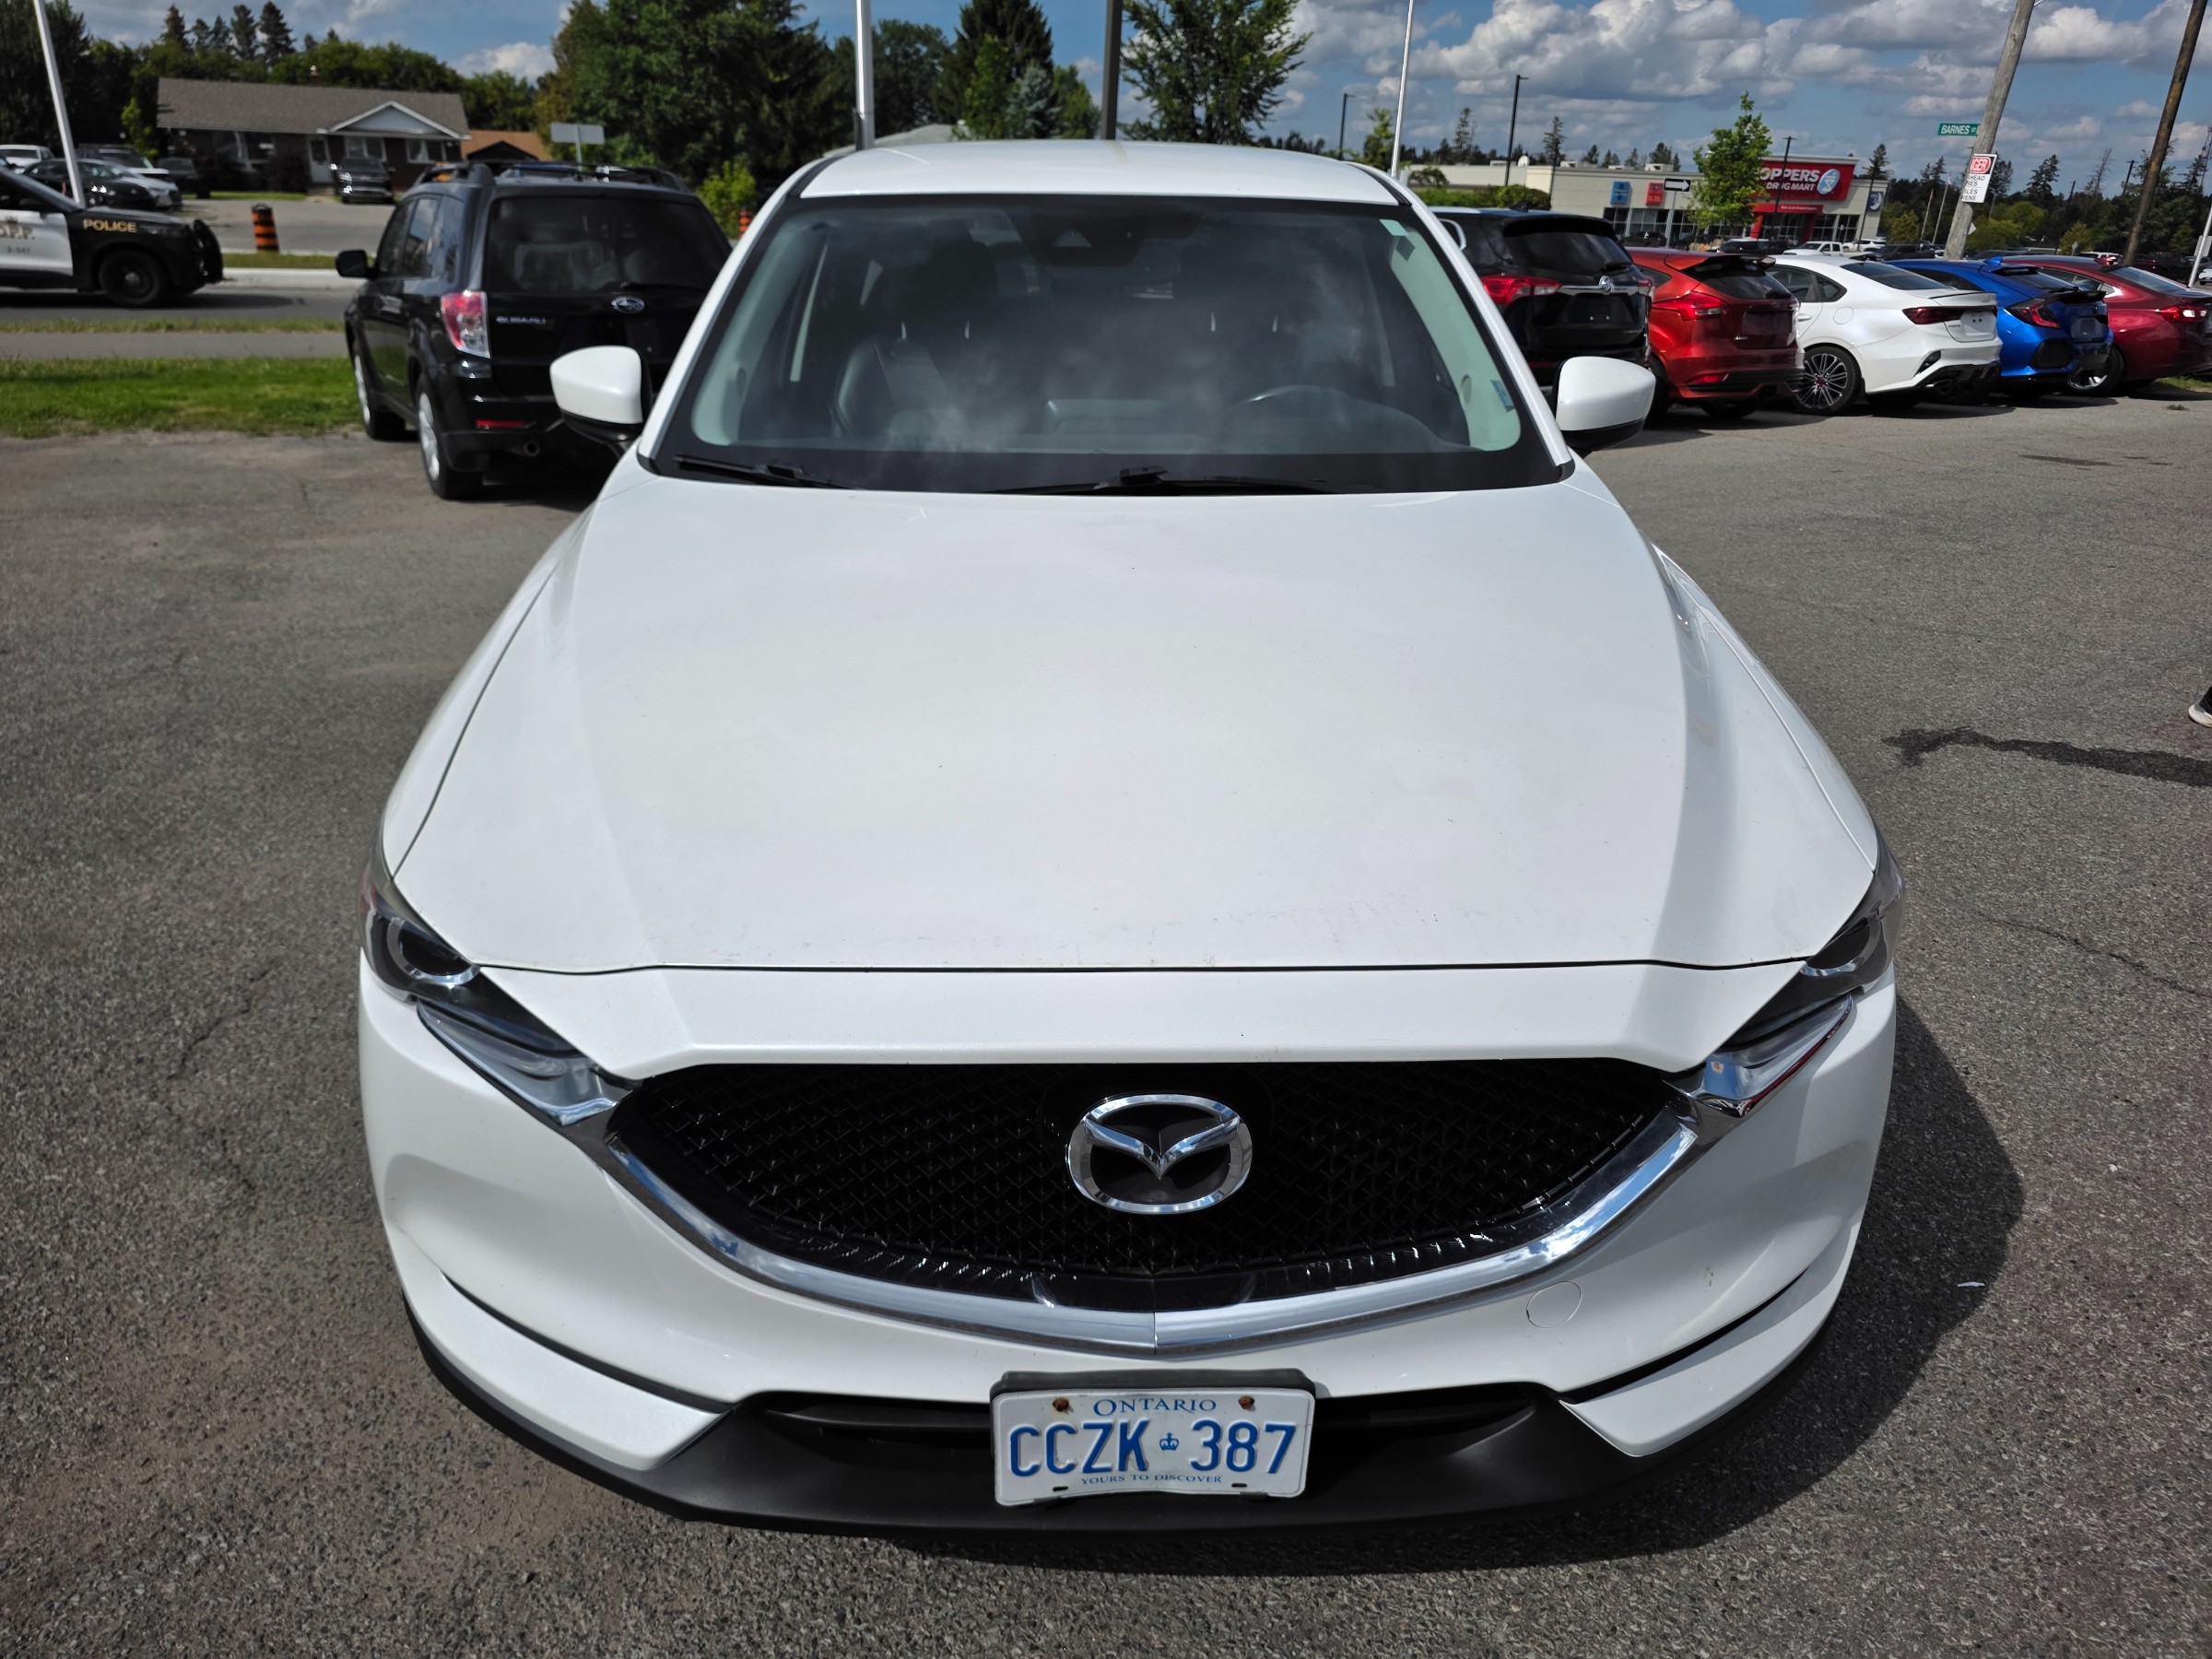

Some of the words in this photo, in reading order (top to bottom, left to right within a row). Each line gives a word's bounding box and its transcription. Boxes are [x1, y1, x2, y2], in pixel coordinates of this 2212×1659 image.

[1940, 124, 1971, 135] BARNES
[1759, 167, 1820, 182] OPPERS
[1791, 182, 1816, 192] MART
[83, 218, 137, 233] POLICE
[1092, 1397, 1218, 1417] ONTARIO
[1009, 1419, 1150, 1477] CCZK
[1190, 1419, 1298, 1475] 387
[1081, 1475, 1125, 1485] YOURS
[1154, 1474, 1223, 1483] DISCOVER
